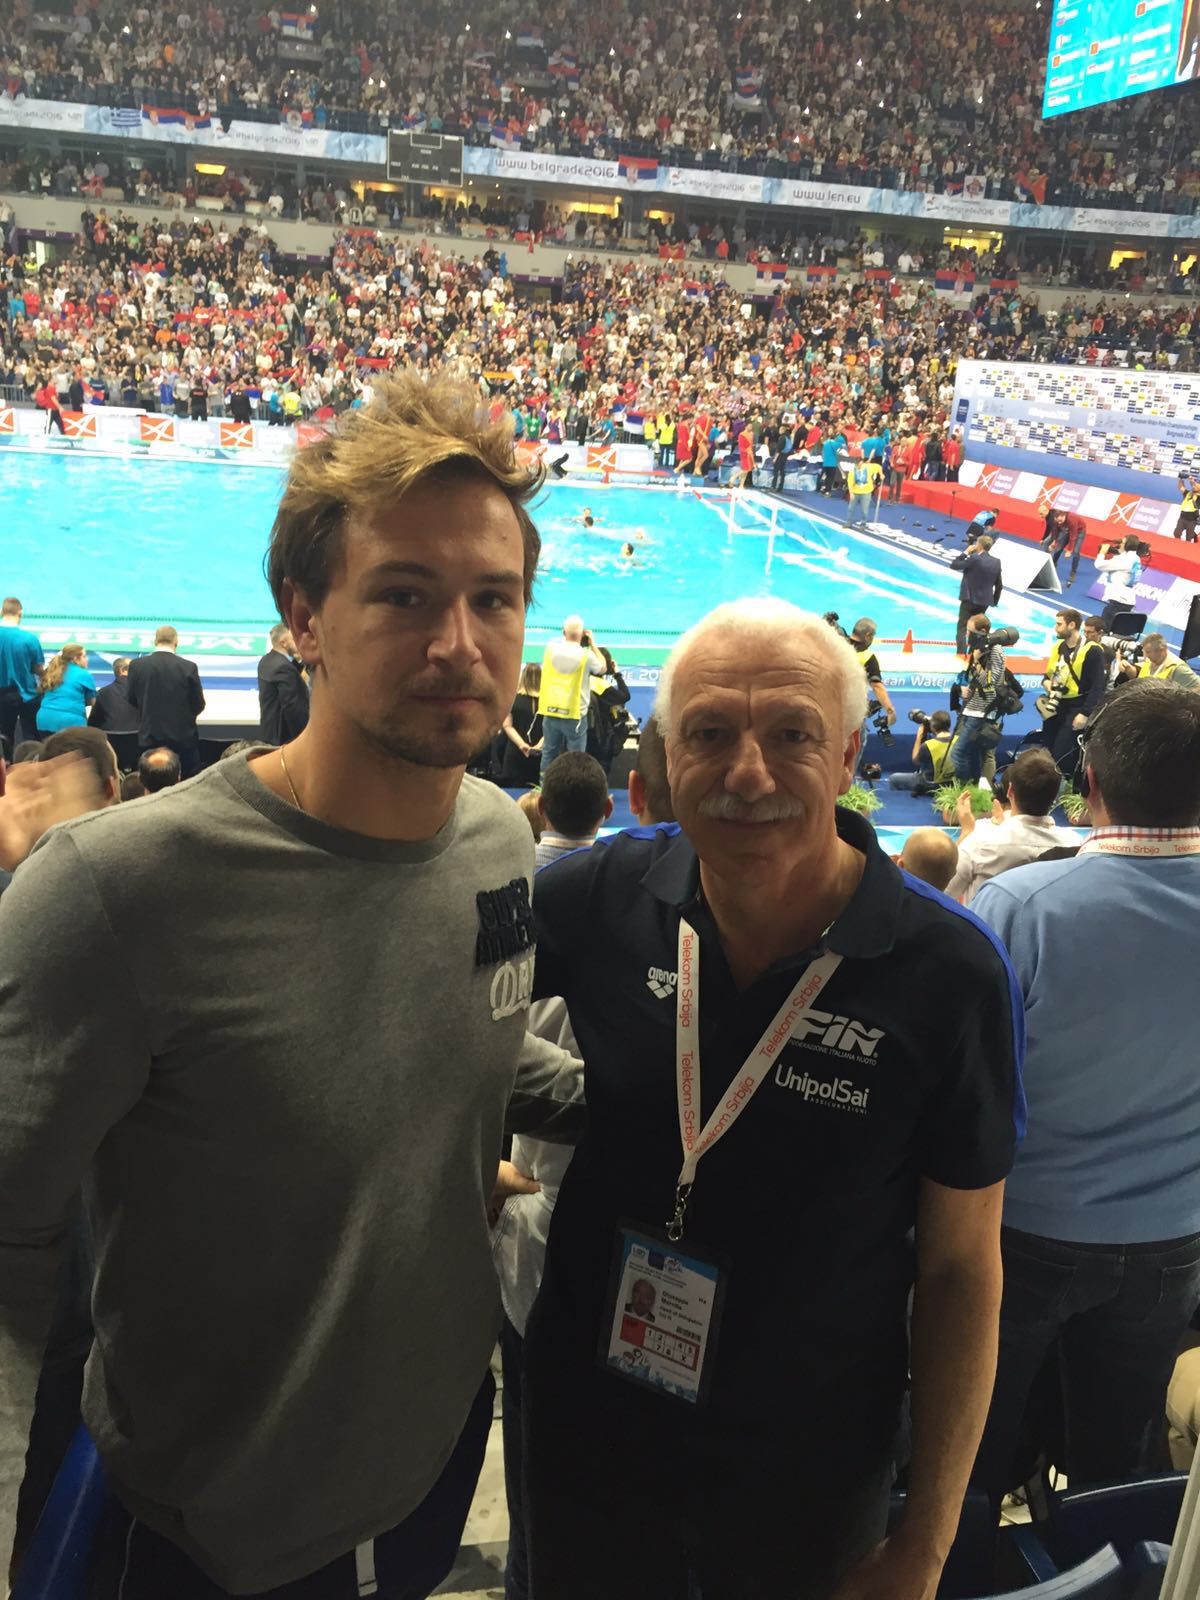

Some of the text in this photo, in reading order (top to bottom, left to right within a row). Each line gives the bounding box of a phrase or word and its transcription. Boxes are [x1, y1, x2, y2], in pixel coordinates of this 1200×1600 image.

[793, 189, 861, 204] www.len.eu
[1133, 845, 1160, 855] Srbija
[647, 966, 678, 986] arena
[679, 932, 695, 1151] Telekom Srbija Telekom Srbija
[725, 1076, 755, 1112] Srbija
[759, 1009, 799, 1058] Telekom
[792, 974, 822, 1009] Srbija
[774, 1063, 871, 1109] UnipolSai
